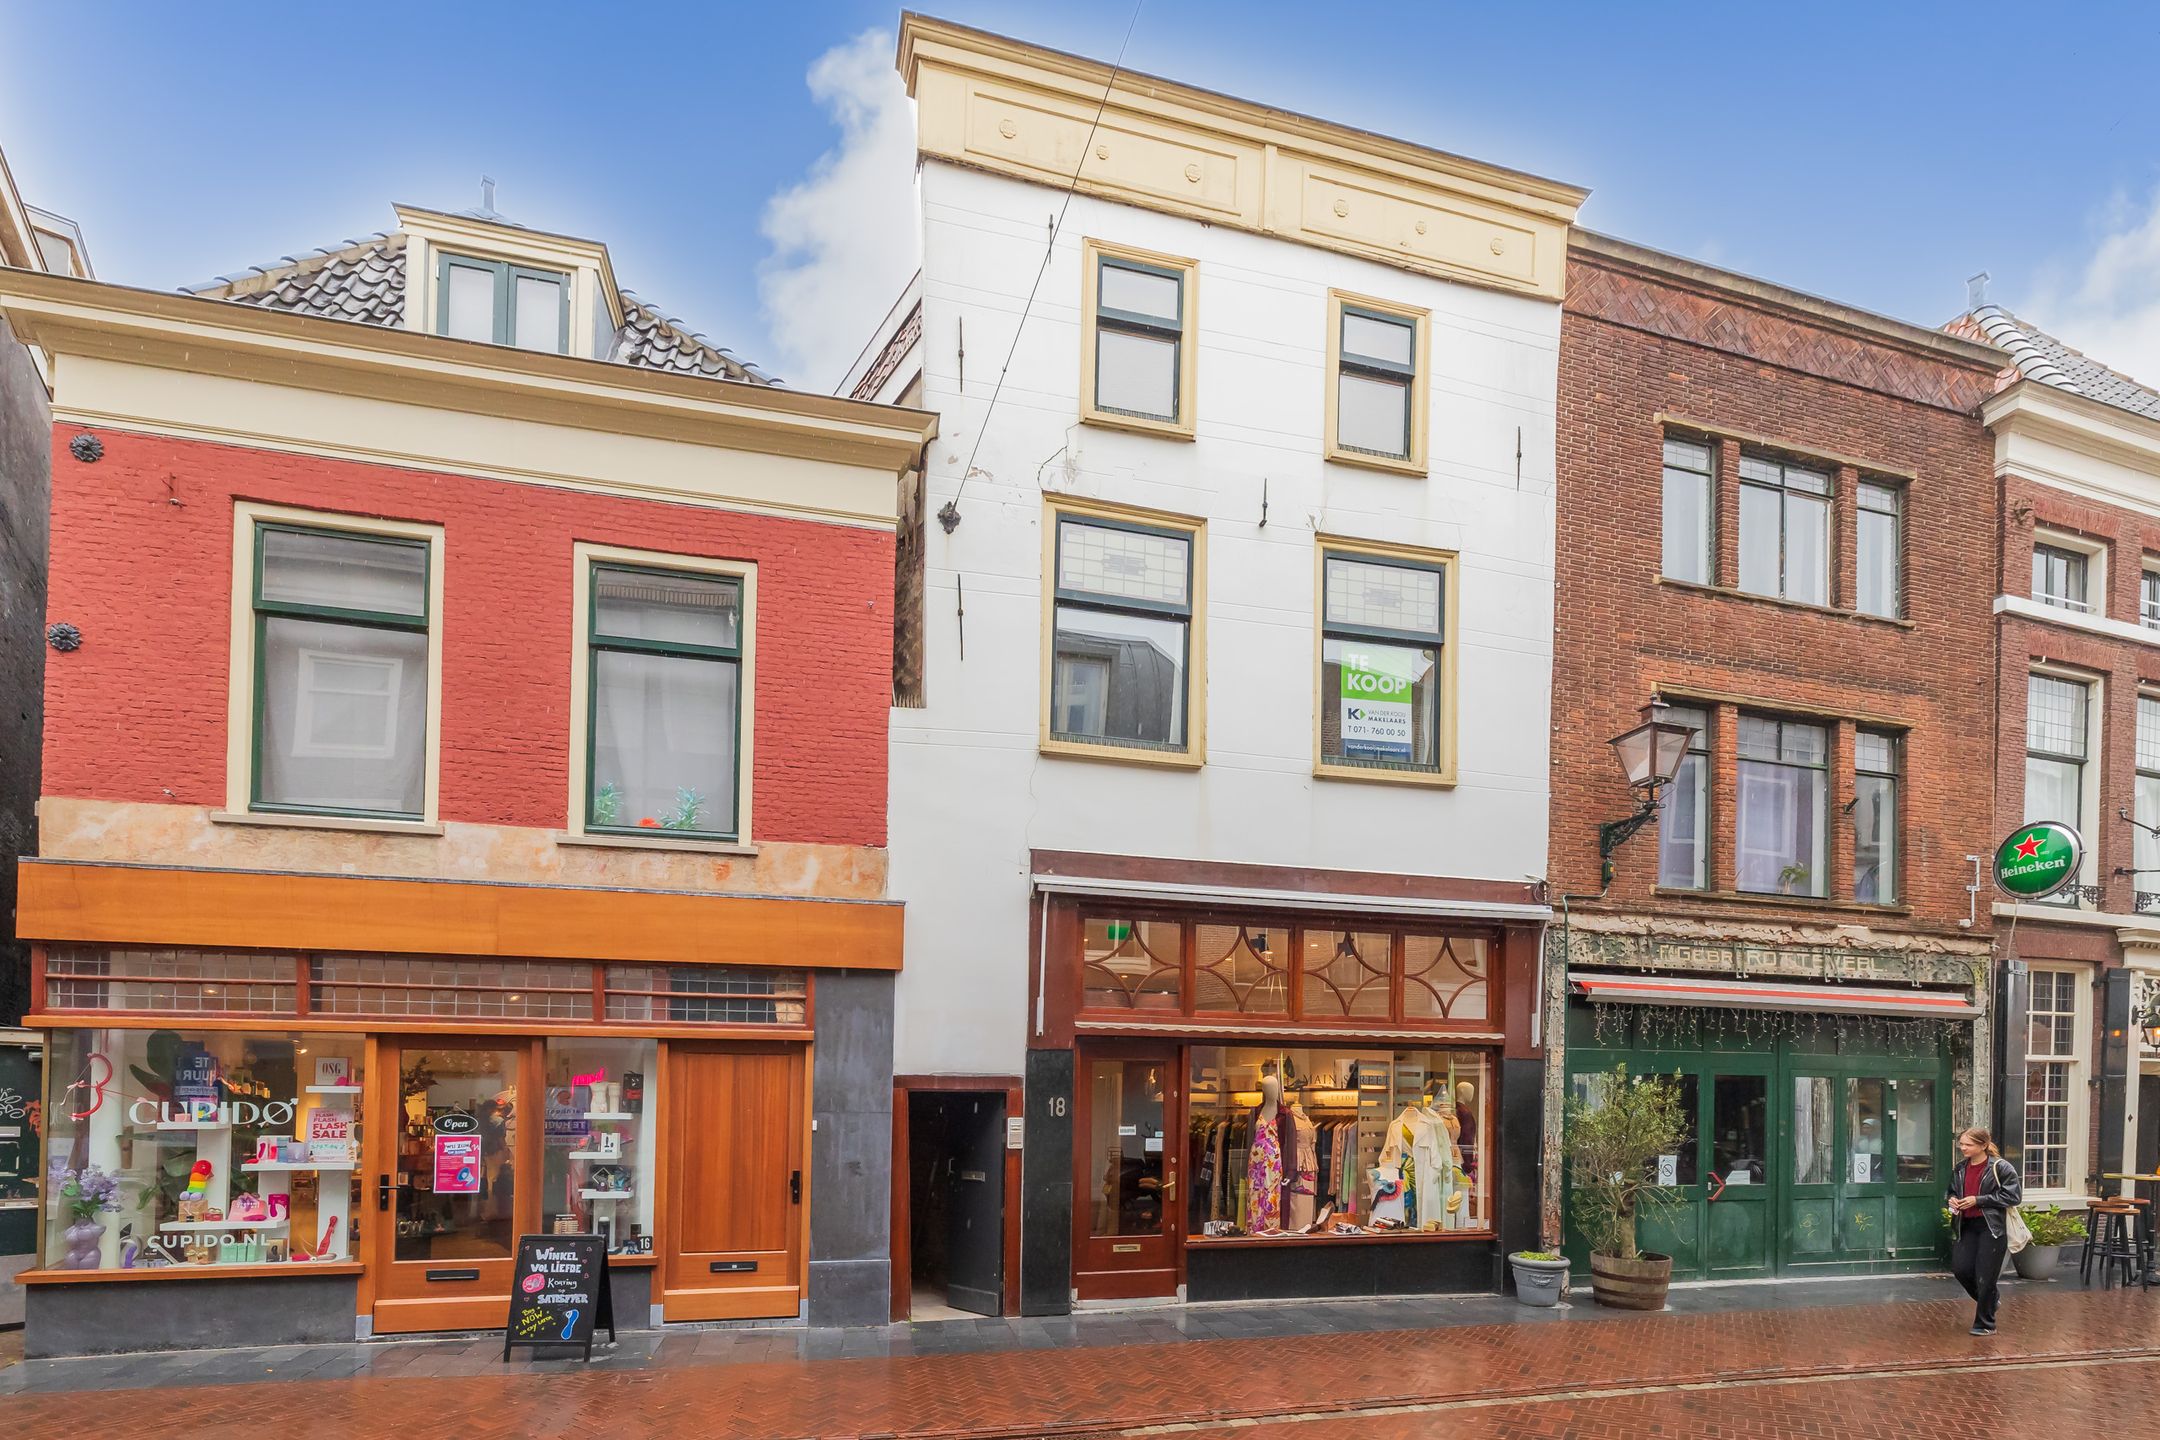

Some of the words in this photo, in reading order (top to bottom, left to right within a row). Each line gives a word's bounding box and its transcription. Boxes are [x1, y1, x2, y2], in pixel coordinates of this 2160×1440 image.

[1348, 653, 1369, 671] TE
[1347, 673, 1407, 694] KOOP
[1368, 716, 1406, 724] MAKELAARS
[1371, 727, 1385, 735] 760
[1386, 728, 1396, 736] 00
[1397, 729, 1406, 737] 50
[2001, 859, 2065, 879] Heineken
[322, 1062, 341, 1074] OSG
[1303, 1074, 1337, 1085] MAIN
[1343, 1074, 1391, 1086] SREET
[129, 1098, 298, 1127] CUPIDO
[1048, 1097, 1066, 1117] 18
[313, 1122, 347, 1130] FLASH
[444, 1118, 468, 1130] Open
[312, 1130, 347, 1139] SALE
[640, 1237, 650, 1249] 16
[530, 1263, 549, 1273] VOL
[521, 1310, 543, 1326] NOW
